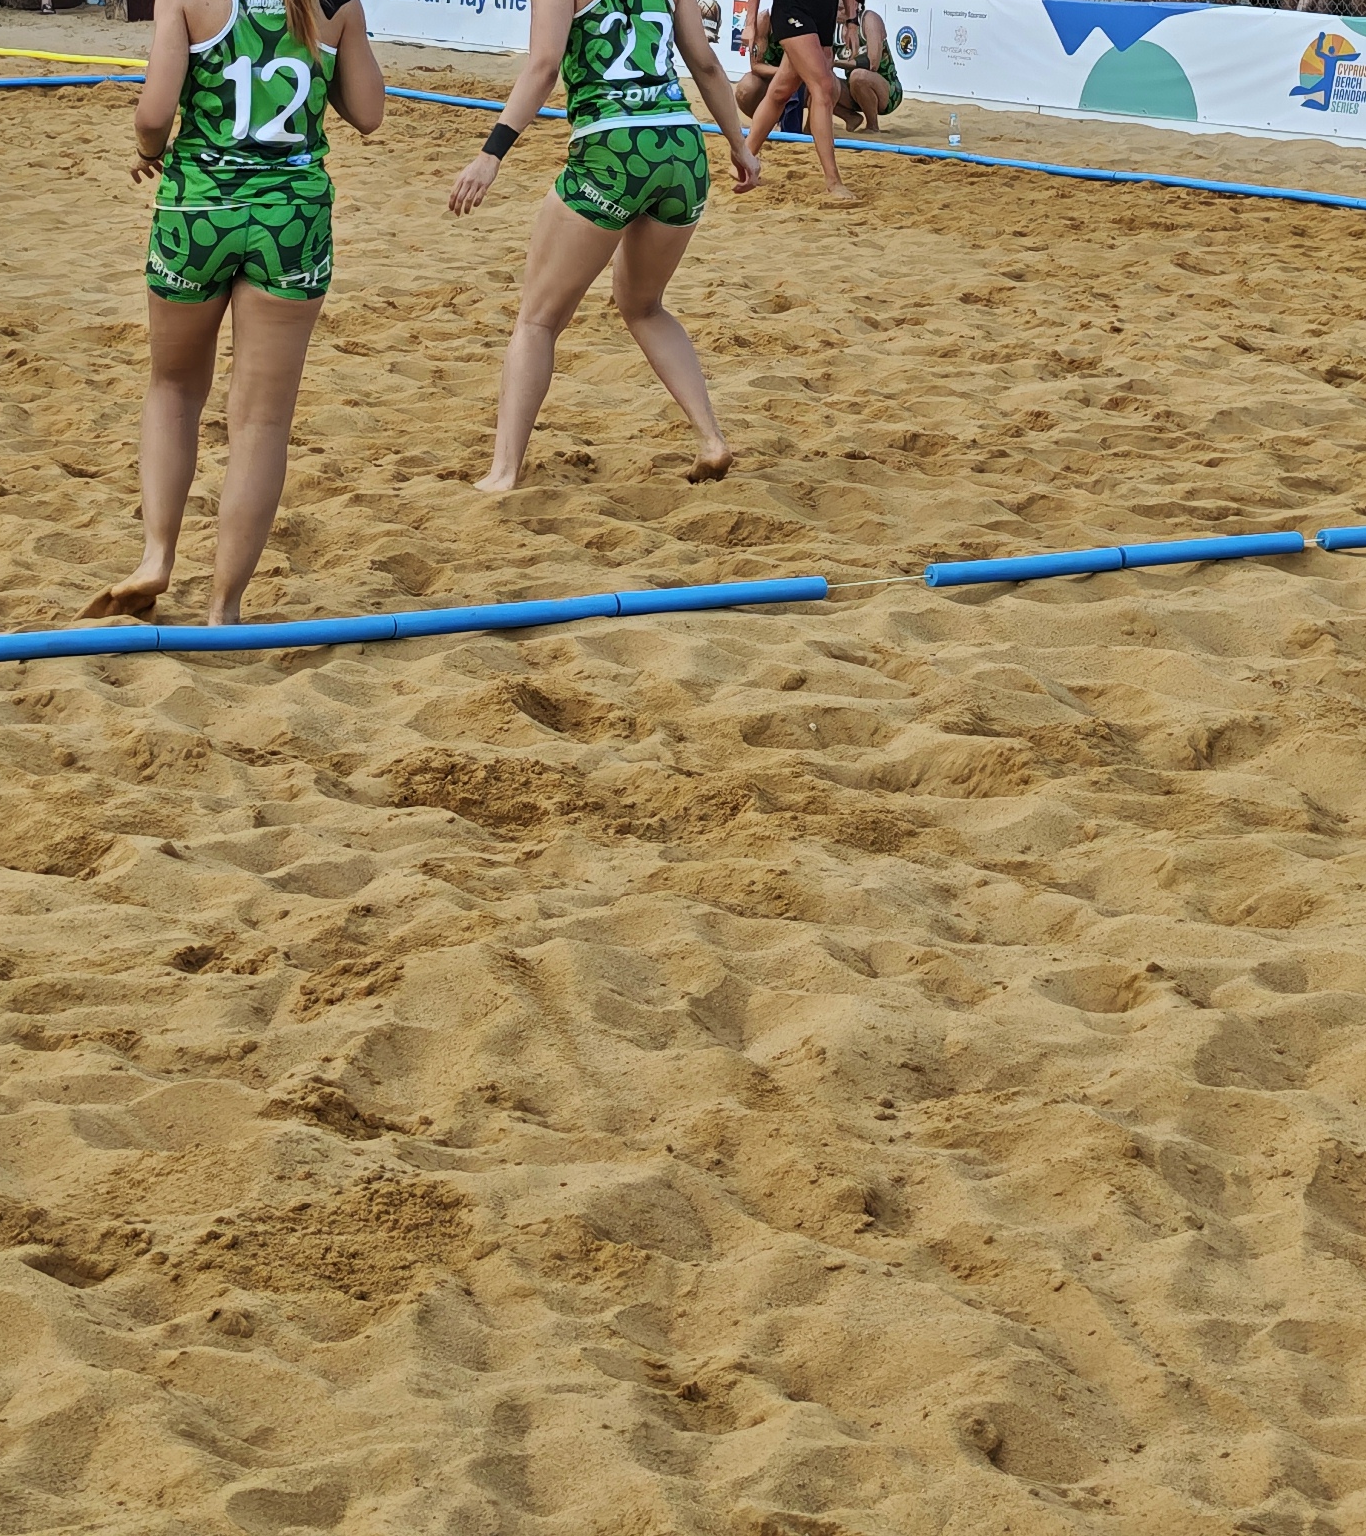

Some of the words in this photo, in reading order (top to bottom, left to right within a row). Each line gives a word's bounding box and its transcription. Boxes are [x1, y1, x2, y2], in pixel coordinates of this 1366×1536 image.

[600, 11, 673, 80] 27
[223, 55, 311, 143] 12
[1335, 76, 1363, 90] BEACH
[1330, 101, 1360, 115] SERIES
